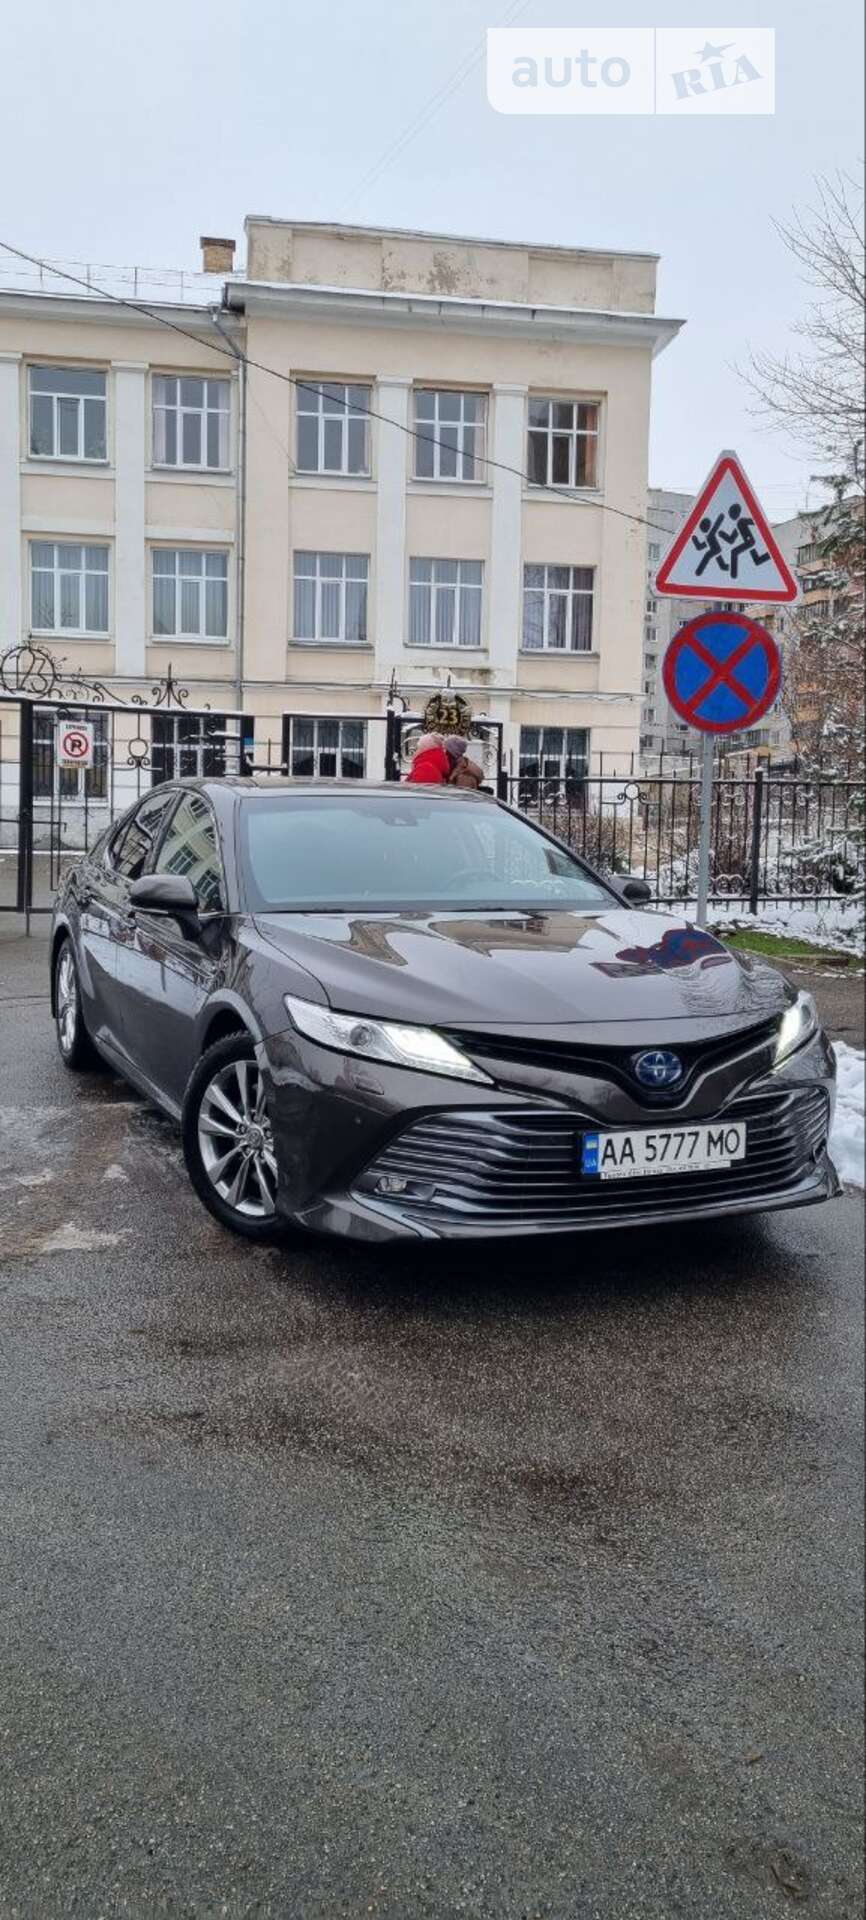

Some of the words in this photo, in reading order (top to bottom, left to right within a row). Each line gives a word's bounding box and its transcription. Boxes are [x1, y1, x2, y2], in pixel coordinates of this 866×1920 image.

[438, 709, 457, 724] 23
[601, 1136, 635, 1166] AA
[645, 1131, 700, 1162] 5777
[707, 1128, 740, 1157] MO
